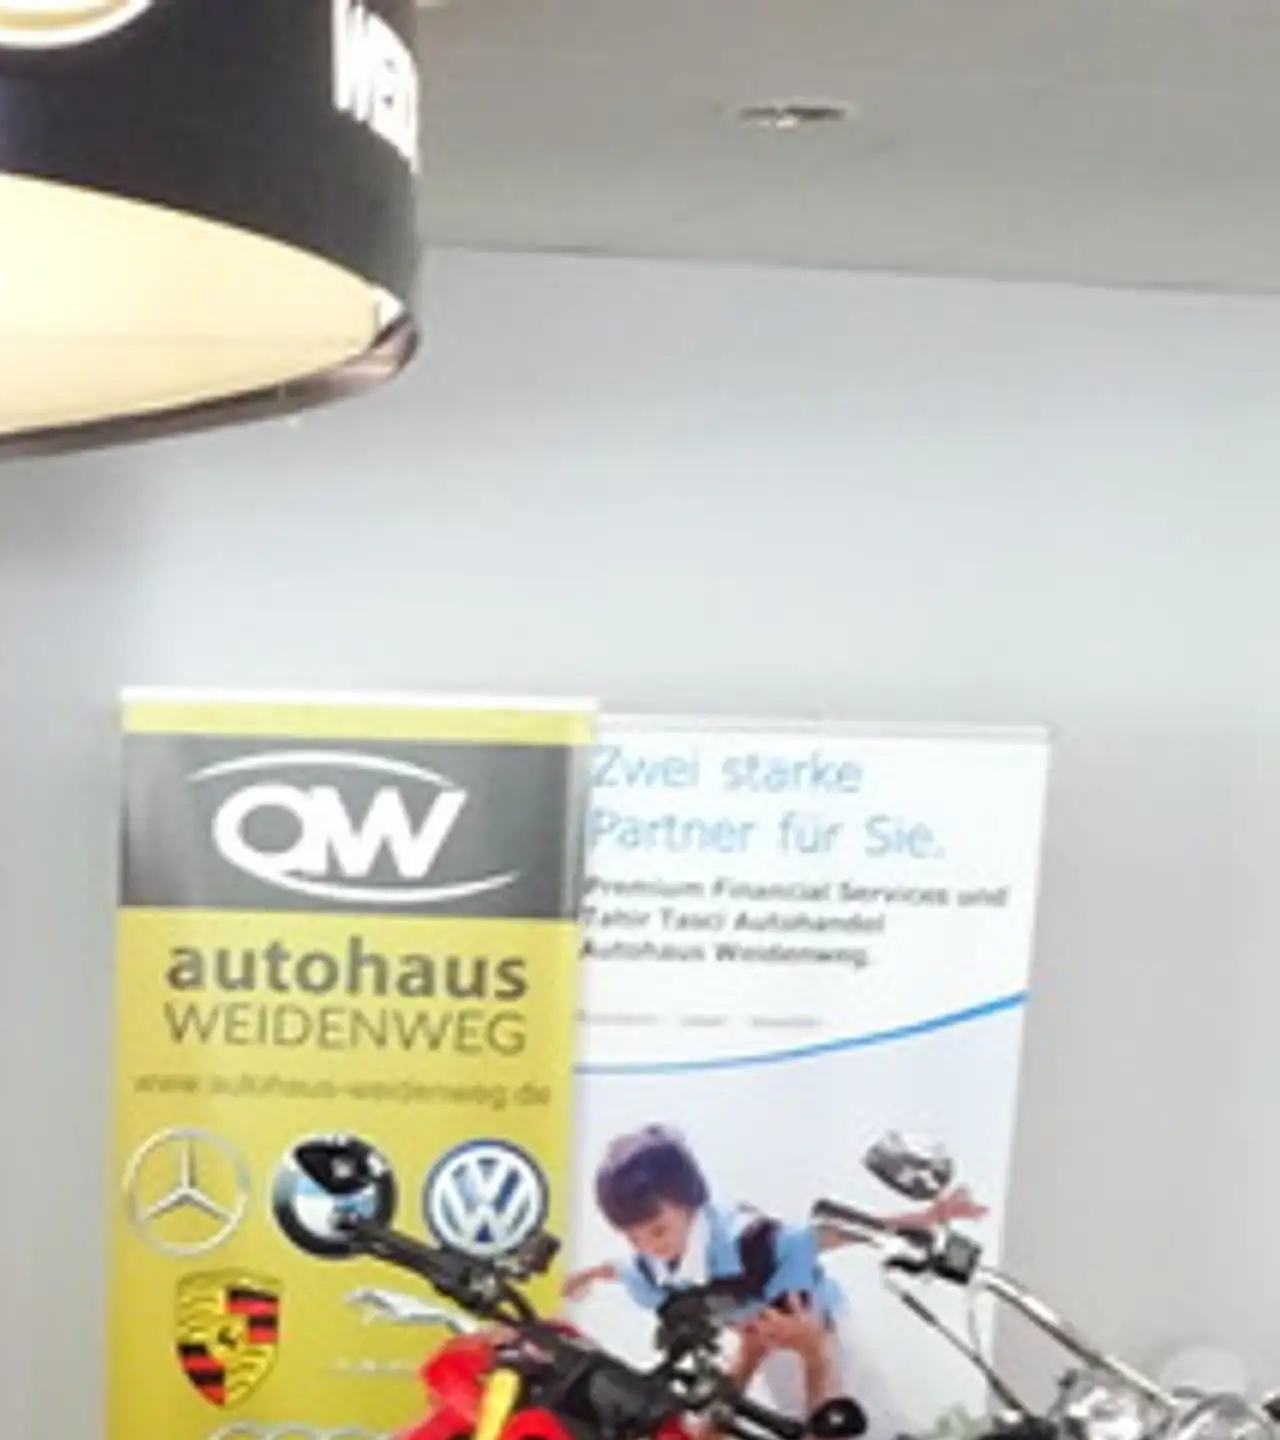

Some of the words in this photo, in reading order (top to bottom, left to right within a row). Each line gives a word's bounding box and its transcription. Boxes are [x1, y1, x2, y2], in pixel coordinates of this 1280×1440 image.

[593, 744, 701, 789] Zwei
[722, 747, 863, 794] starke
[589, 809, 756, 854] Partner
[166, 935, 528, 1001] autohaus
[163, 1002, 528, 1057] WEIDENWEG
